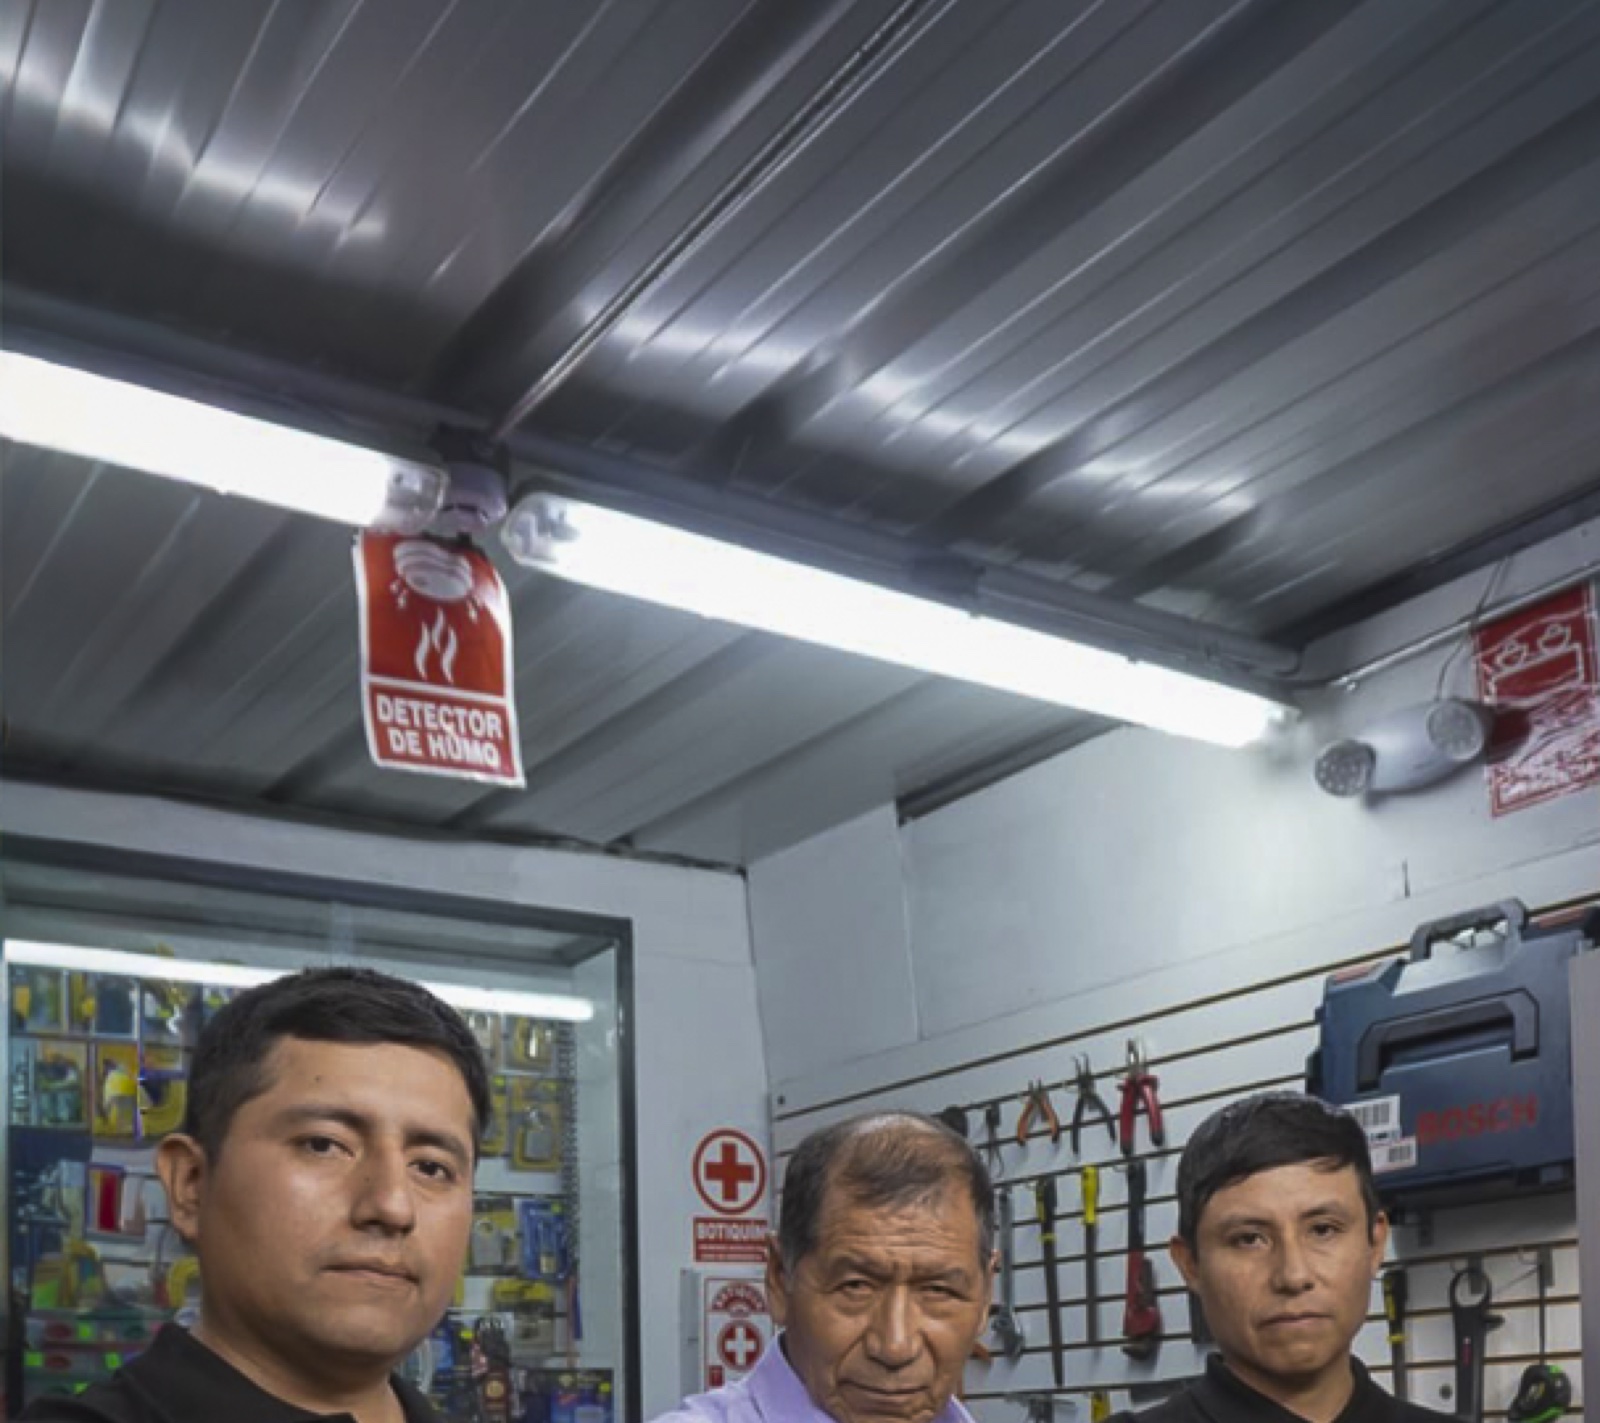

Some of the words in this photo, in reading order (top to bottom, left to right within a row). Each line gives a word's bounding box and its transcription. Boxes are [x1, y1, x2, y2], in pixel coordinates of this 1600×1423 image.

[376, 694, 504, 739] DETECTOR
[388, 727, 423, 757] DE
[1417, 1091, 1538, 1144] BOSCH
